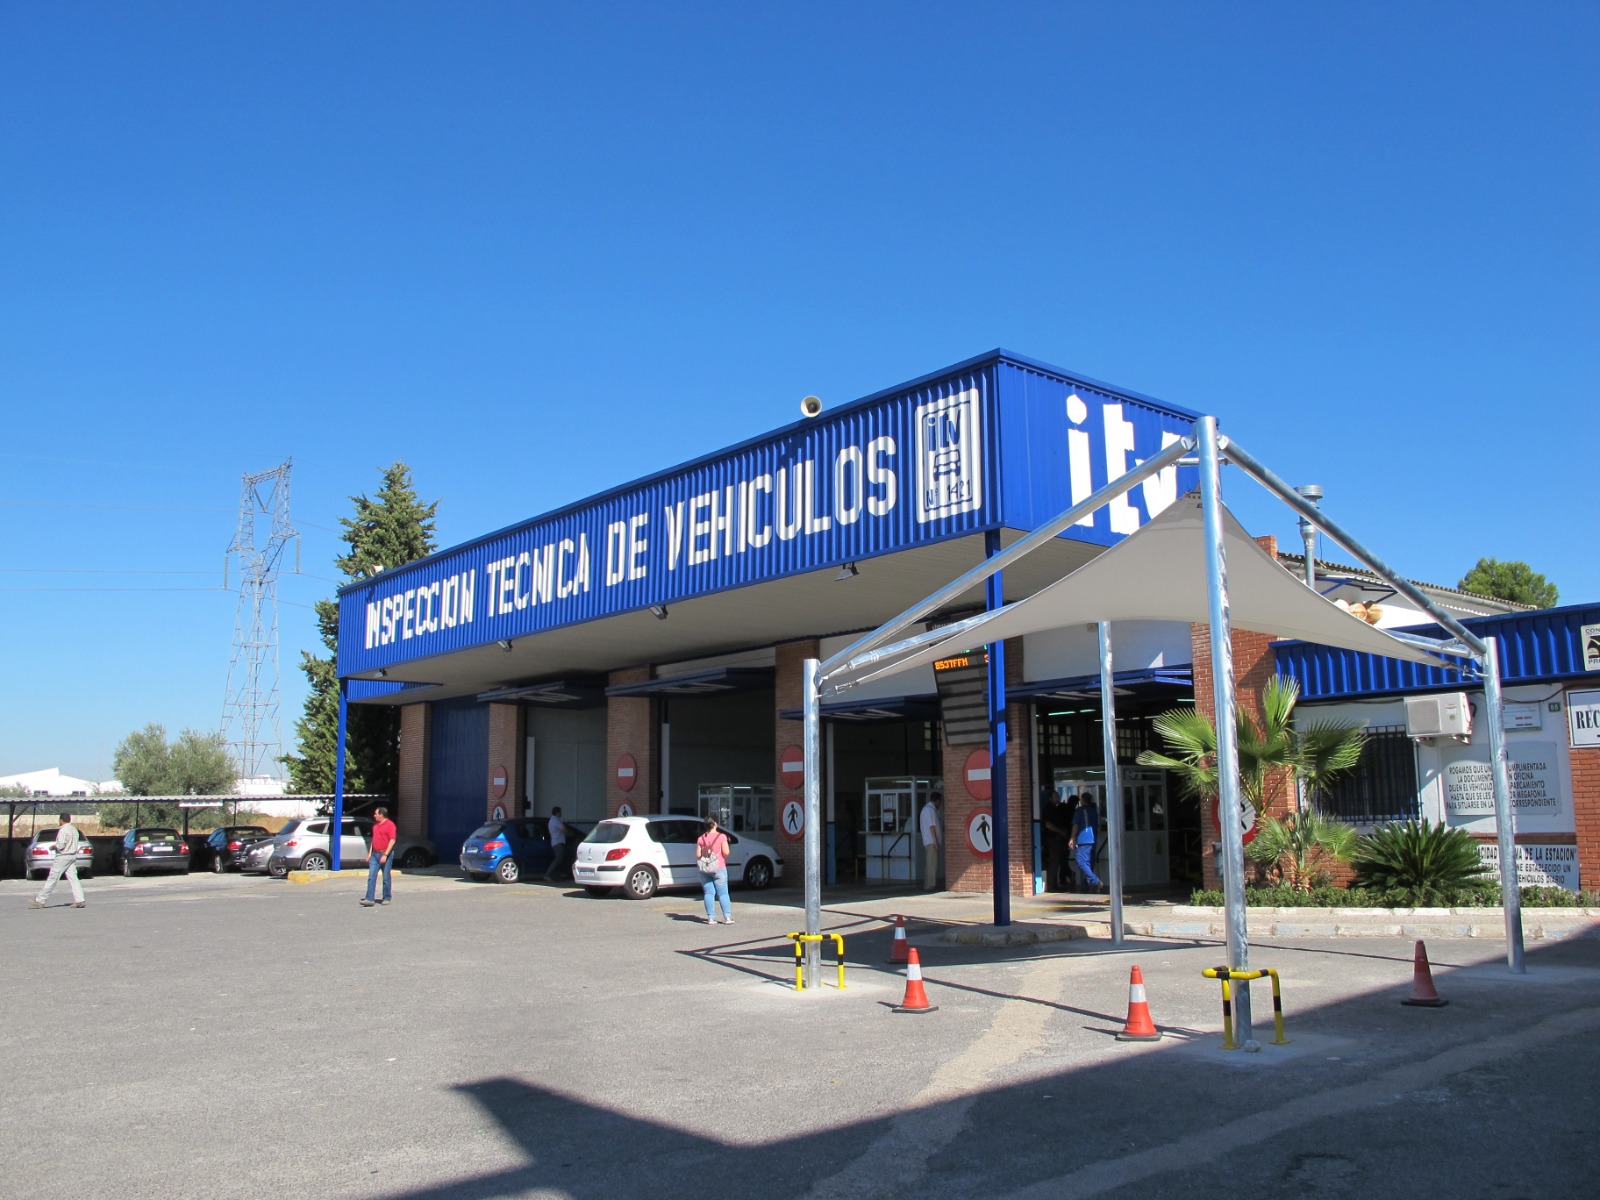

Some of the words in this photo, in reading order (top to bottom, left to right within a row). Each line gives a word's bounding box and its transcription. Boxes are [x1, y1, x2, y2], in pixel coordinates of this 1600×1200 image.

[1066, 394, 1181, 535] itv
[365, 568, 476, 650] INSPECCION
[486, 532, 590, 618] TECNICA
[606, 512, 649, 588] DE
[664, 436, 897, 571] VEHICULOS
[1448, 765, 1472, 775] ROGAMOS
[1473, 764, 1483, 774] QUE
[1508, 762, 1547, 771] UMPLIMENTADA
[1457, 775, 1463, 783] LA
[1464, 774, 1493, 783] DOCUMENTA
[1513, 772, 1534, 781] OFICINA
[1448, 783, 1463, 792] DEJEN
[1463, 783, 1469, 791] EL
[1470, 782, 1493, 791] VEHICULO
[1509, 780, 1545, 790] PARCAMIENTO
[1451, 793, 1465, 801] HASTA
[1465, 792, 1475, 801] QUE
[1476, 792, 1483, 800] SE
[1483, 791, 1491, 800] LES
[1516, 789, 1547, 799] MEGAFONIA
[1458, 801, 1480, 810] SITUARSE
[1481, 801, 1487, 809] EN
[1488, 800, 1494, 809] LA
[1510, 797, 1556, 808] ORRESPONDIENTE
[1525, 847, 1533, 861] DE
[1535, 847, 1543, 861] LA
[1525, 863, 1561, 873] ESTABLECIDO
[1563, 863, 1571, 873] UN
[1518, 874, 1544, 884] EHICULOS
[1545, 874, 1565, 885] DIARIO
